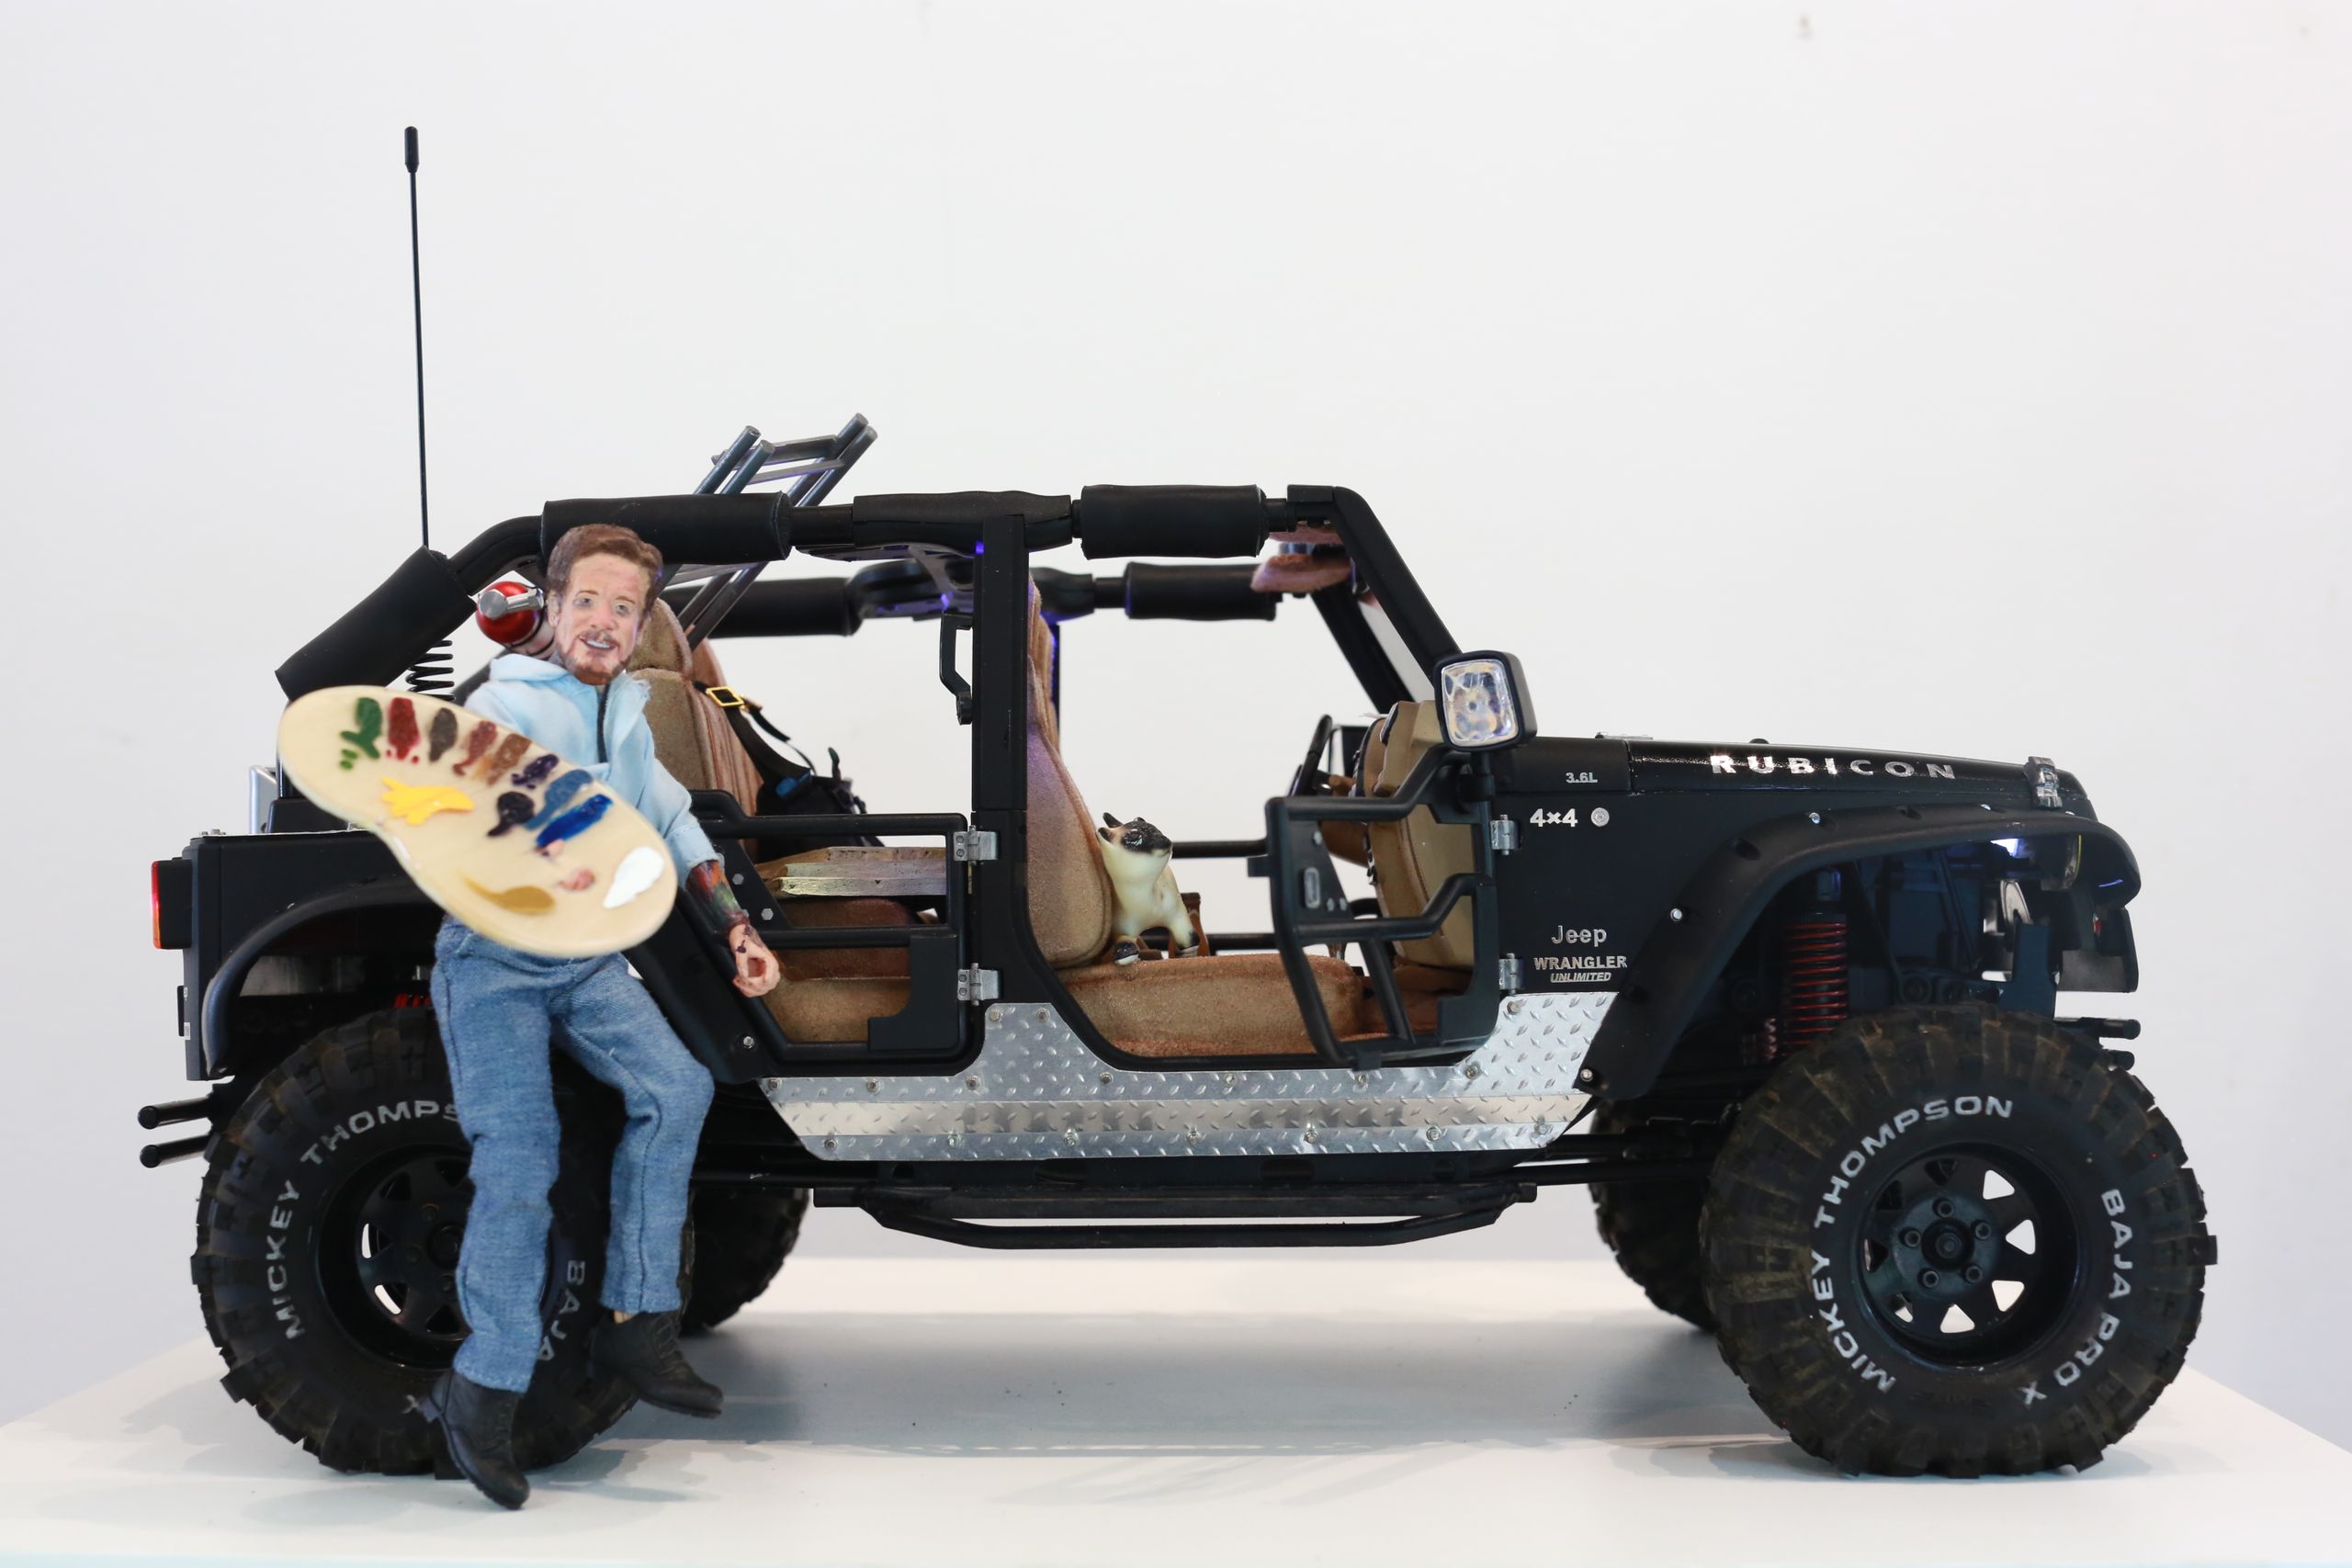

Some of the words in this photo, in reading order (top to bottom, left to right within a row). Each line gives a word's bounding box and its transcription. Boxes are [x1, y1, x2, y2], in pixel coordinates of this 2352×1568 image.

[1566, 772, 1598, 784] 3.6L
[1710, 755, 1956, 779] RUBICON
[1530, 808, 1578, 828] 4x4
[1551, 925, 1607, 947] Jeep
[1533, 955, 1628, 970] WRANGLER
[1550, 972, 1611, 983] UNLIMITED
[1814, 1096, 2012, 1228] THOMPSON
[266, 1179, 305, 1339] MICKEY
[300, 1100, 459, 1166] THOMPS
[2101, 1189, 2133, 1299] BAJA
[537, 1259, 586, 1361] BAJA
[1811, 1249, 1896, 1393] MICKEY
[2053, 1313, 2120, 1386] PRO
[2019, 1381, 2047, 1406] X
